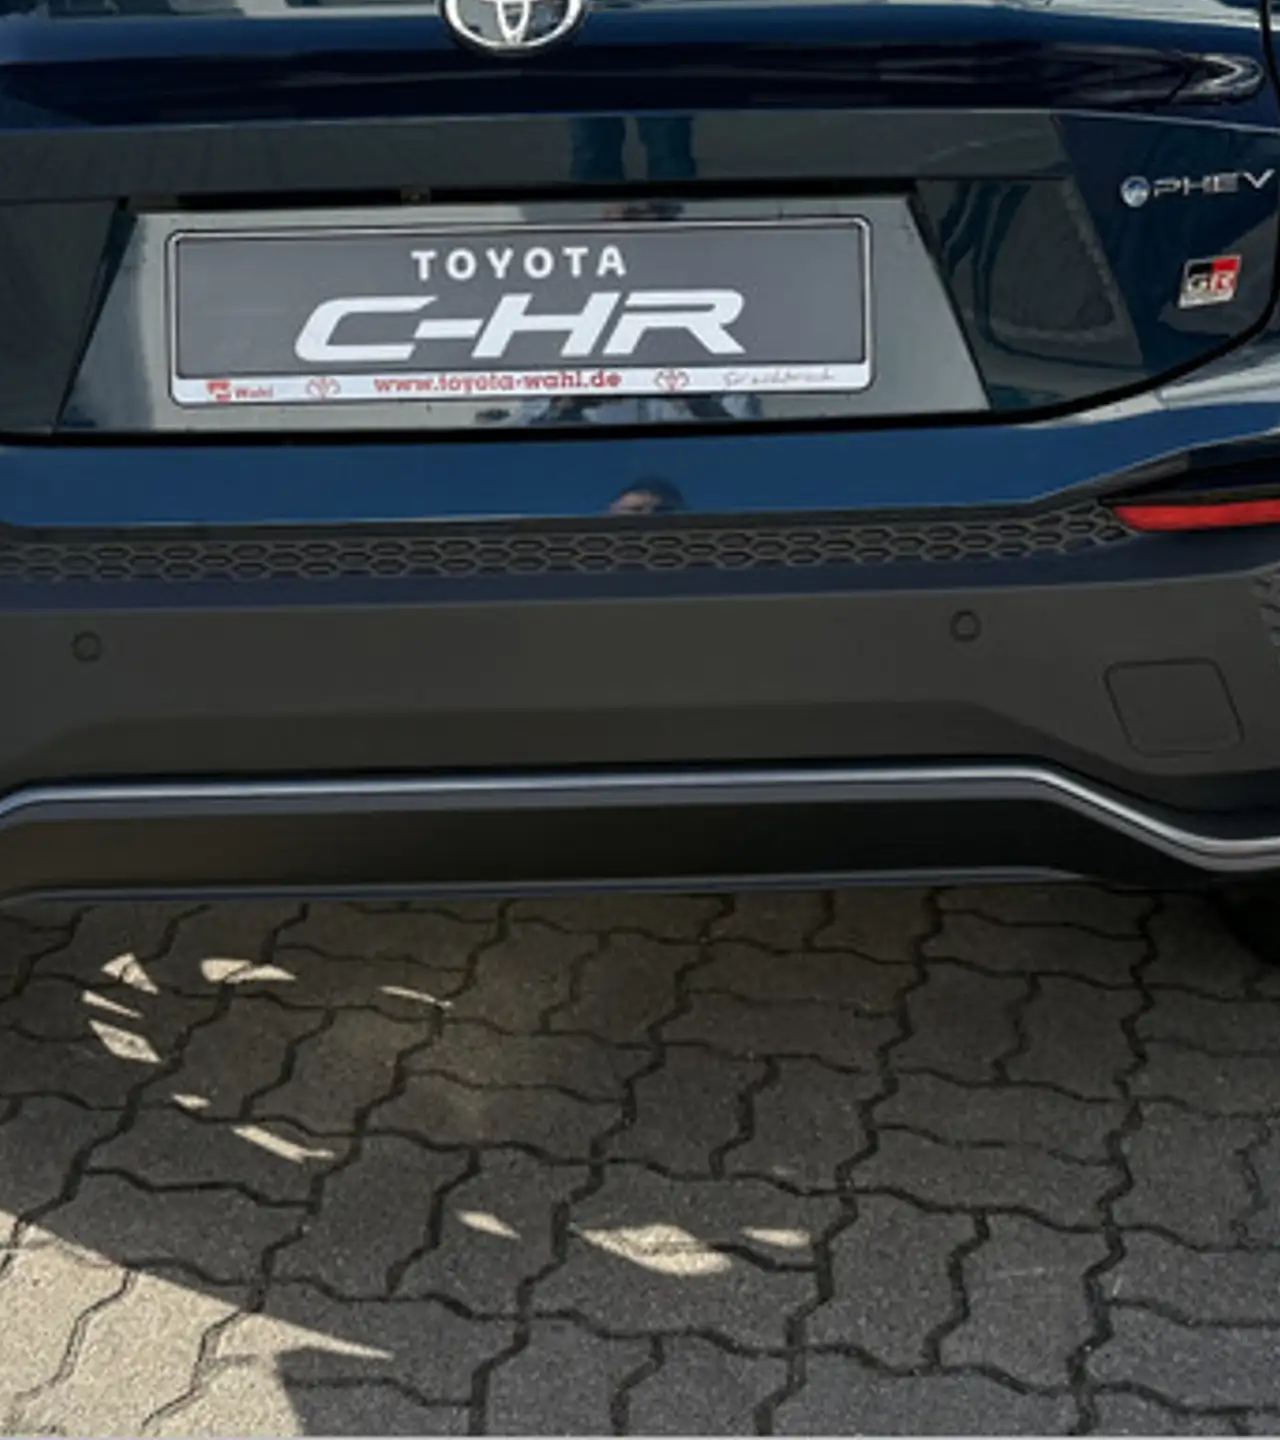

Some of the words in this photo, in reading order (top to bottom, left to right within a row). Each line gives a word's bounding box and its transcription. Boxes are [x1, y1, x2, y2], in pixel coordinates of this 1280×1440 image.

[1153, 169, 1274, 196] PHEV
[412, 245, 627, 281] TOYOTA
[295, 289, 746, 362] C-HR
[373, 370, 622, 394] www.toyota-wahl.de
